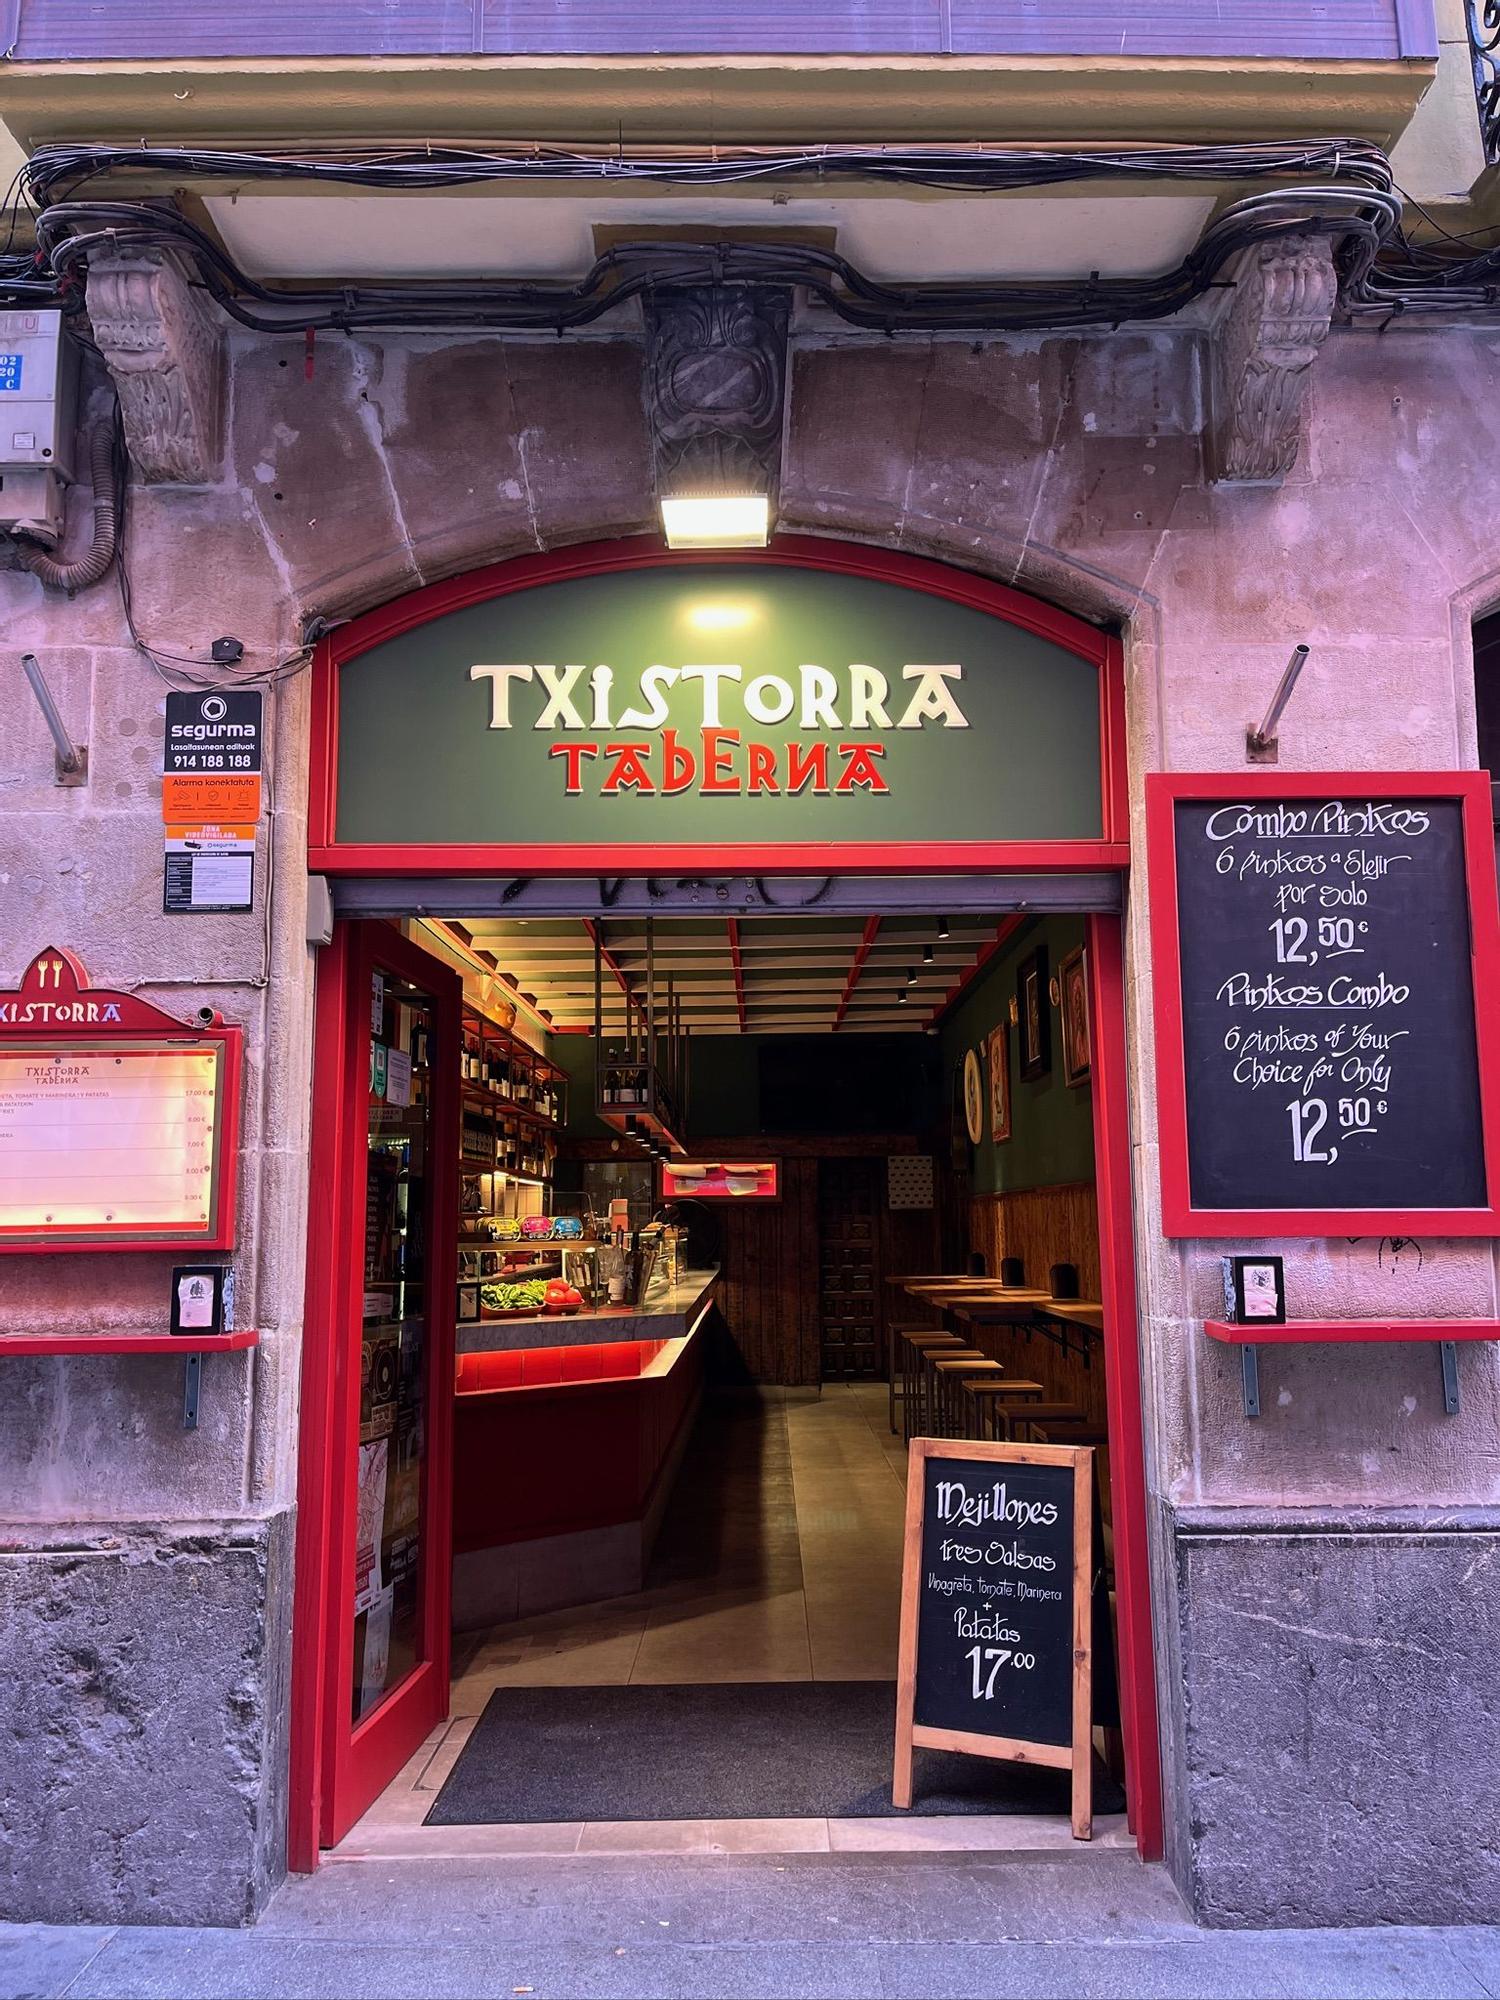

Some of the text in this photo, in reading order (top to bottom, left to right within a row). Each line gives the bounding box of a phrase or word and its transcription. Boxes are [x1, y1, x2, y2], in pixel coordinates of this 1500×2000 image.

[170, 743, 255, 751] Lasaitasunean adituak
[171, 724, 256, 741] segurma
[174, 754, 251, 768] 914 188 188
[173, 779, 255, 787] Alarma konektatuta
[1205, 801, 1430, 841] Combo Pintxos
[1215, 845, 1234, 873] 6
[1239, 849, 1327, 880] pintxos
[1330, 852, 1341, 864] a
[1273, 883, 1316, 913] por
[1216, 971, 1410, 1012] Pintxos Combo
[1224, 1023, 1410, 1058] 6 pintxos of Your
[25, 1066, 90, 1077] TXISTORRA
[1233, 1054, 1392, 1096] Choice for Only
[935, 1481, 1058, 1530] Mejillones
[985, 1541, 1056, 1571] Salsas
[1017, 1580, 1062, 1603] Marinera
[953, 1606, 1021, 1643] Patatas
